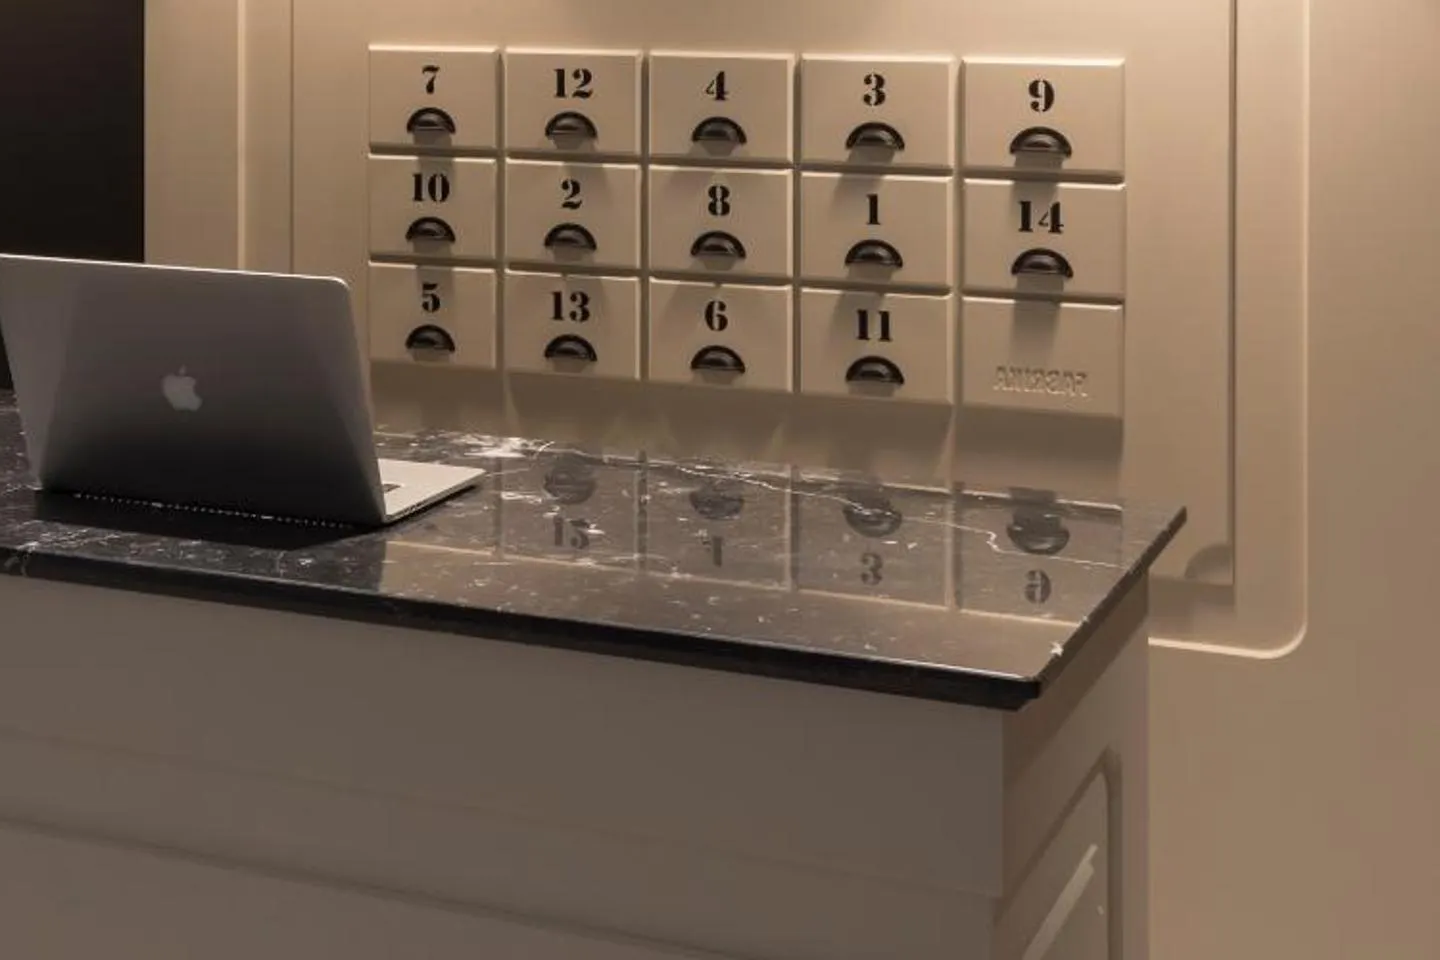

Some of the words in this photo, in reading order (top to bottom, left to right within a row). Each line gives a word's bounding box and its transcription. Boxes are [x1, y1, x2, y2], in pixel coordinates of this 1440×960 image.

[421, 65, 441, 95] 7
[554, 68, 593, 99] 12
[705, 71, 729, 102] 4
[863, 73, 886, 107] 3
[1028, 79, 1055, 113] 9
[413, 172, 450, 203] 10
[561, 179, 583, 210] 2
[707, 185, 731, 217] 8
[866, 193, 881, 226] 1
[1018, 199, 1065, 234] 14
[421, 281, 441, 313] 5
[552, 291, 591, 323] 13
[704, 300, 729, 332] 6
[856, 308, 892, 343] 11
